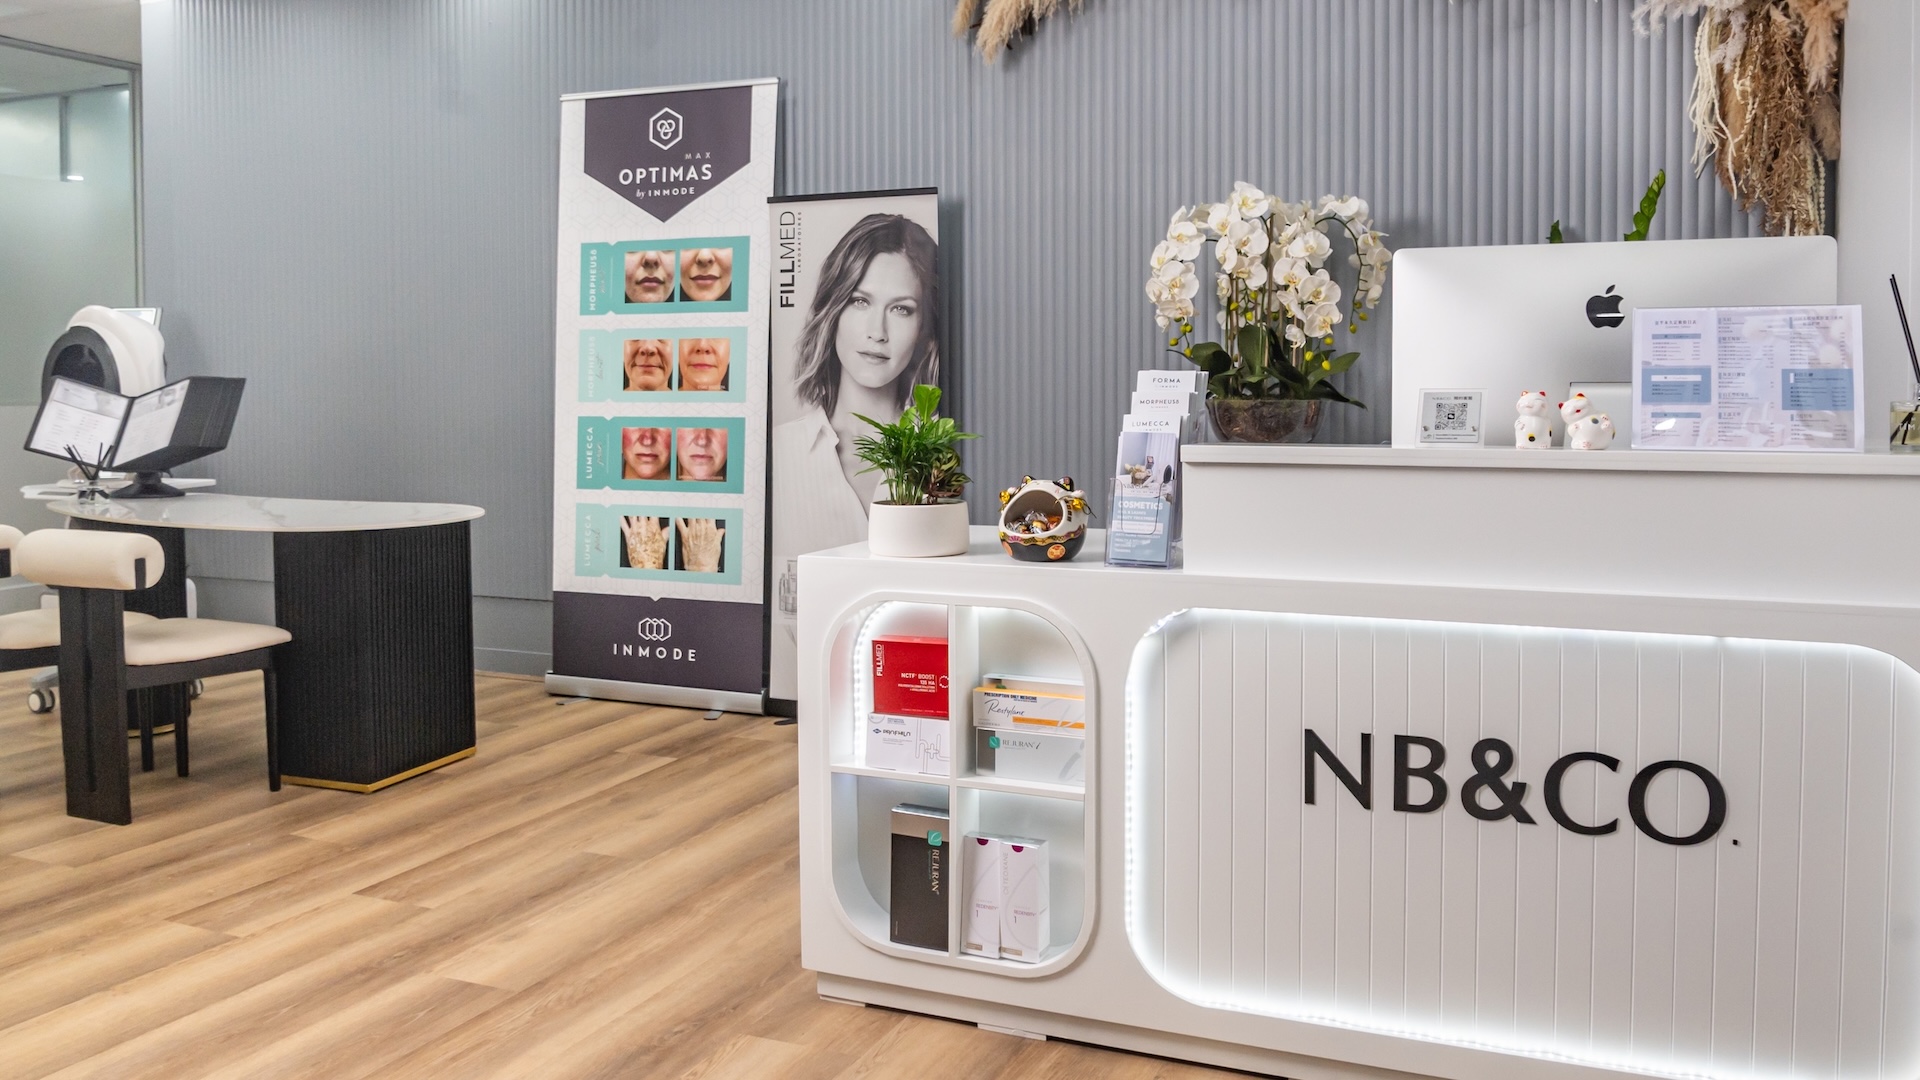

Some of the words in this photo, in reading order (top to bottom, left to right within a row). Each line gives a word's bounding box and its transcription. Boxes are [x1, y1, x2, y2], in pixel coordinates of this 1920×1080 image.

[685, 152, 711, 160] MAX
[619, 163, 712, 185] OPTIMAS
[636, 189, 646, 199] by
[648, 187, 695, 197] INMODE
[780, 211, 795, 308] FILLMED
[589, 249, 598, 311] MORPHEUS8
[586, 427, 594, 479] LUMECCA
[1118, 500, 1164, 510] COSMETICS
[584, 515, 592, 567] LUMECCA
[613, 643, 696, 662] INMODE
[984, 698, 1025, 718] Restylane
[1304, 728, 1739, 846] NB&CO.
